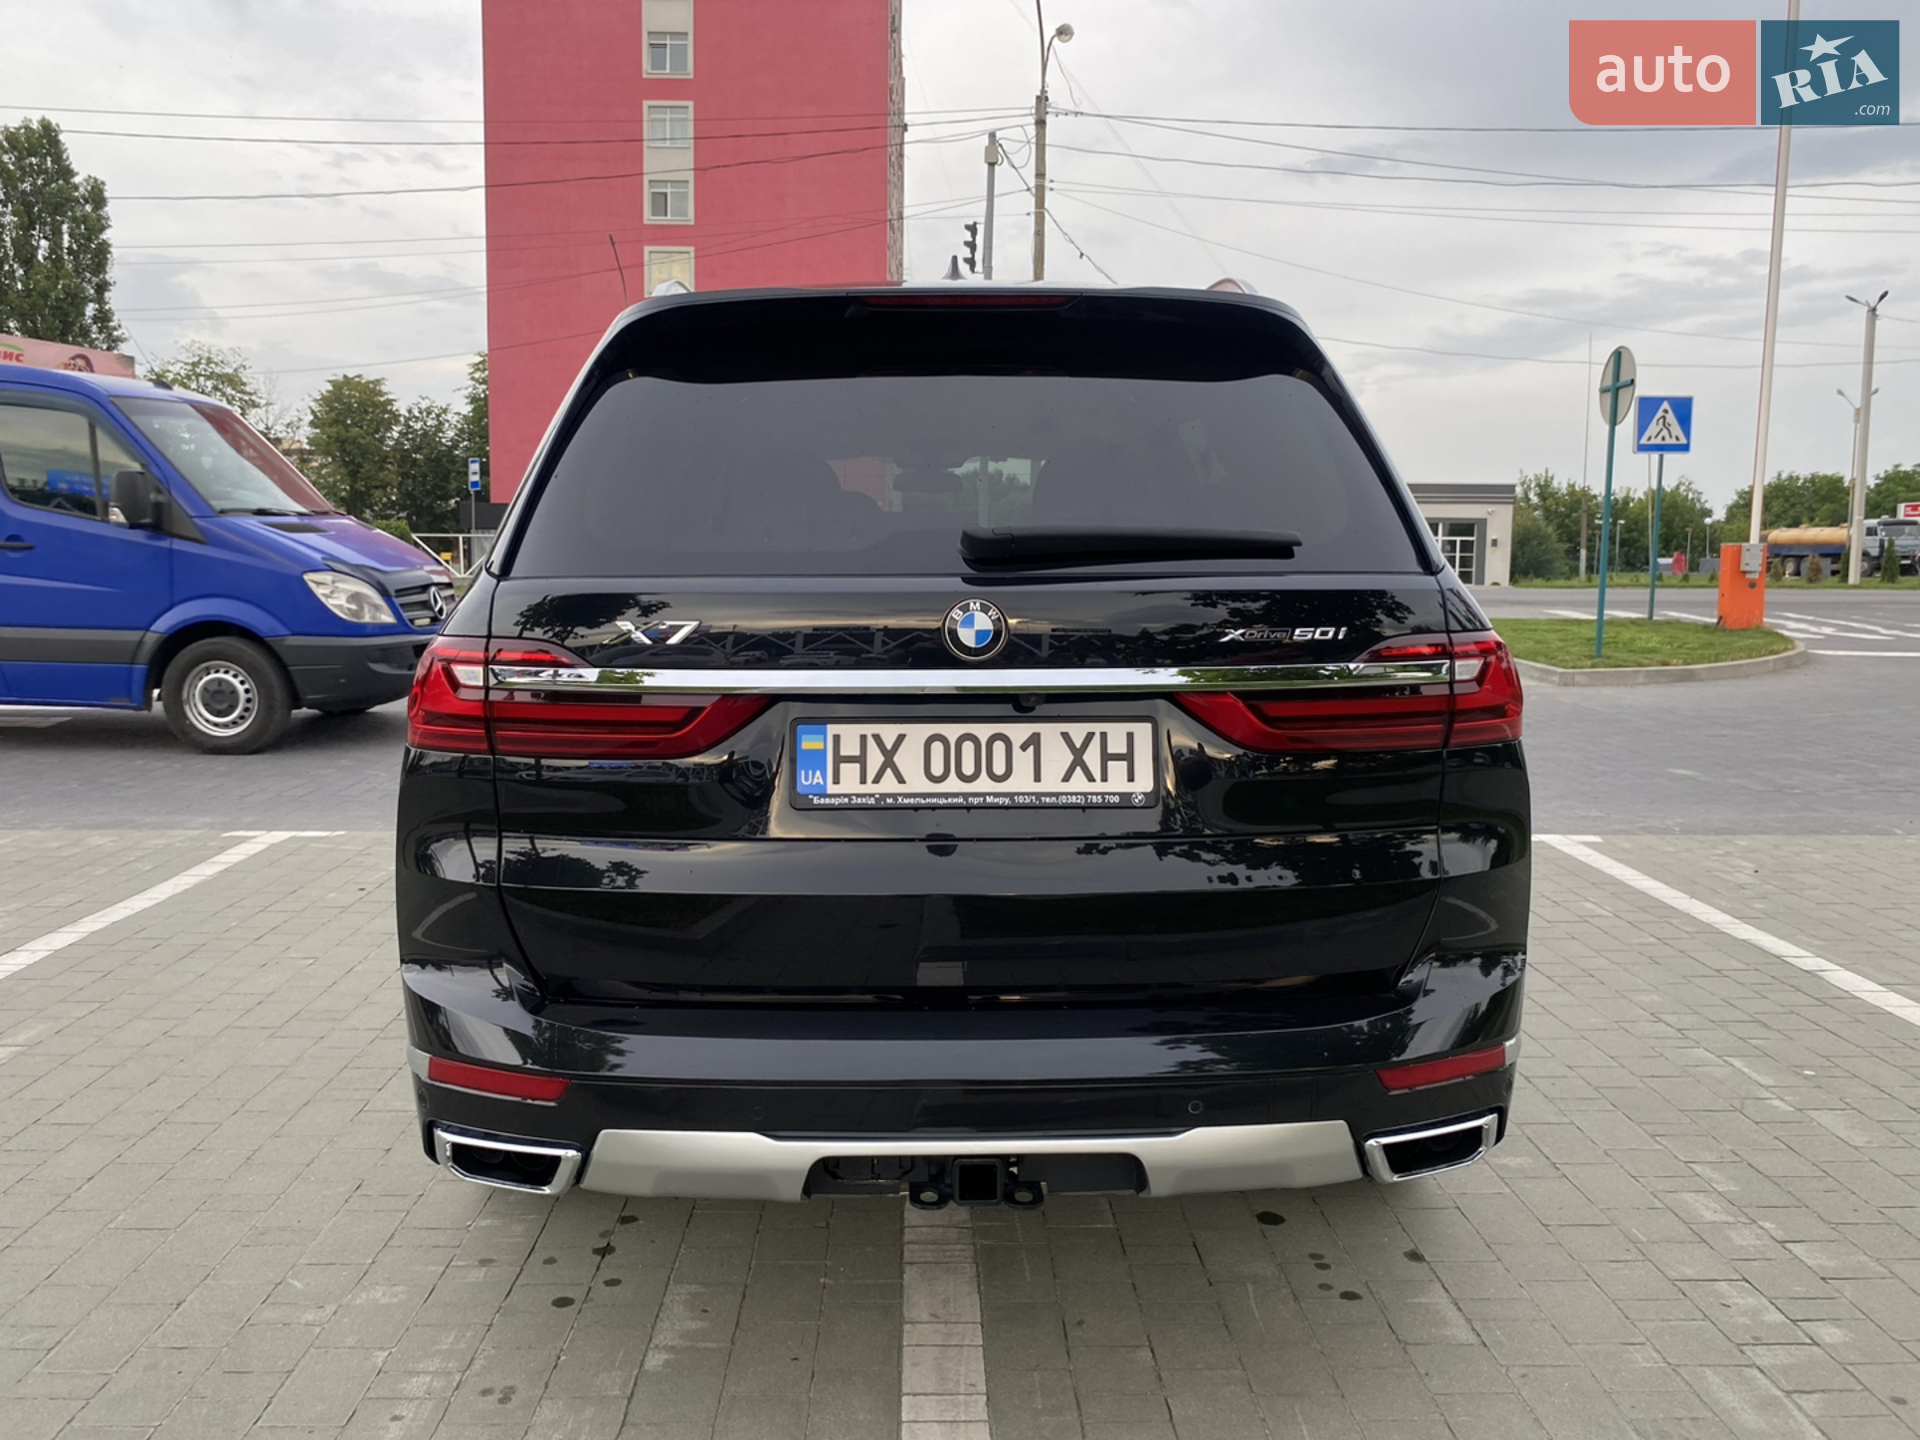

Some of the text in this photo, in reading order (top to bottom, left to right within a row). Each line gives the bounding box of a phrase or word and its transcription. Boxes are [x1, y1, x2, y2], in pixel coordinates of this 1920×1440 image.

[951, 601, 1000, 620] BMW
[601, 620, 701, 645] X7
[922, 732, 1042, 784] 0001
[800, 770, 824, 786] UA
[1086, 795, 1103, 804] 785
[1103, 795, 1120, 804] 700
